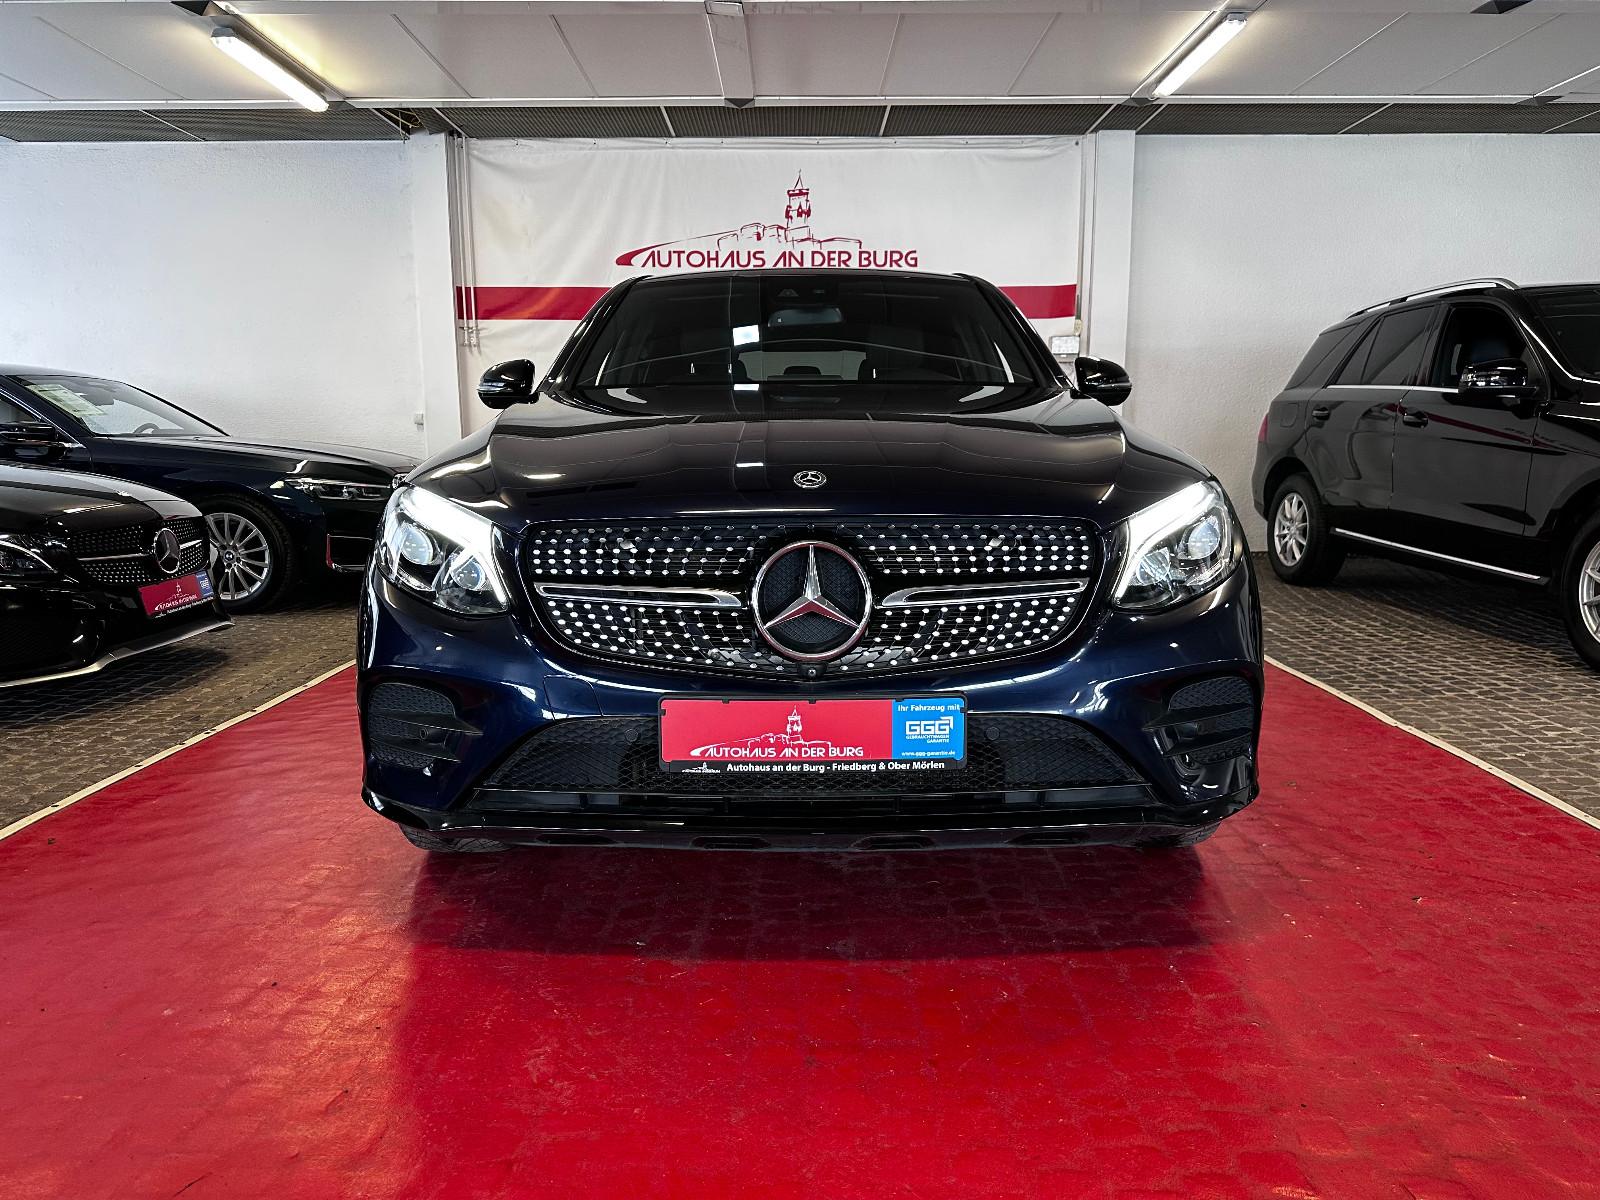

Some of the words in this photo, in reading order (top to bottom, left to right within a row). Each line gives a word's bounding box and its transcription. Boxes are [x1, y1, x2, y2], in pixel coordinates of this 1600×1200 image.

[641, 250, 766, 268] AUTOHAUS
[772, 250, 804, 268] AN
[811, 250, 852, 268] DER
[858, 250, 918, 268] BURG
[911, 704, 945, 713] Fahrzeug
[905, 720, 950, 735] GGG
[704, 747, 777, 758] AUTOHAUS
[779, 747, 798, 758] AN
[801, 747, 826, 758] DER
[828, 747, 864, 758] BURG
[726, 763, 770, 772] Autohaus
[787, 763, 801, 772] der
[803, 763, 825, 774] Burg
[832, 762, 877, 772] Friedberg
[878, 762, 886, 770] &
[887, 762, 910, 770] Ober
[912, 760, 945, 770] Mörlen
